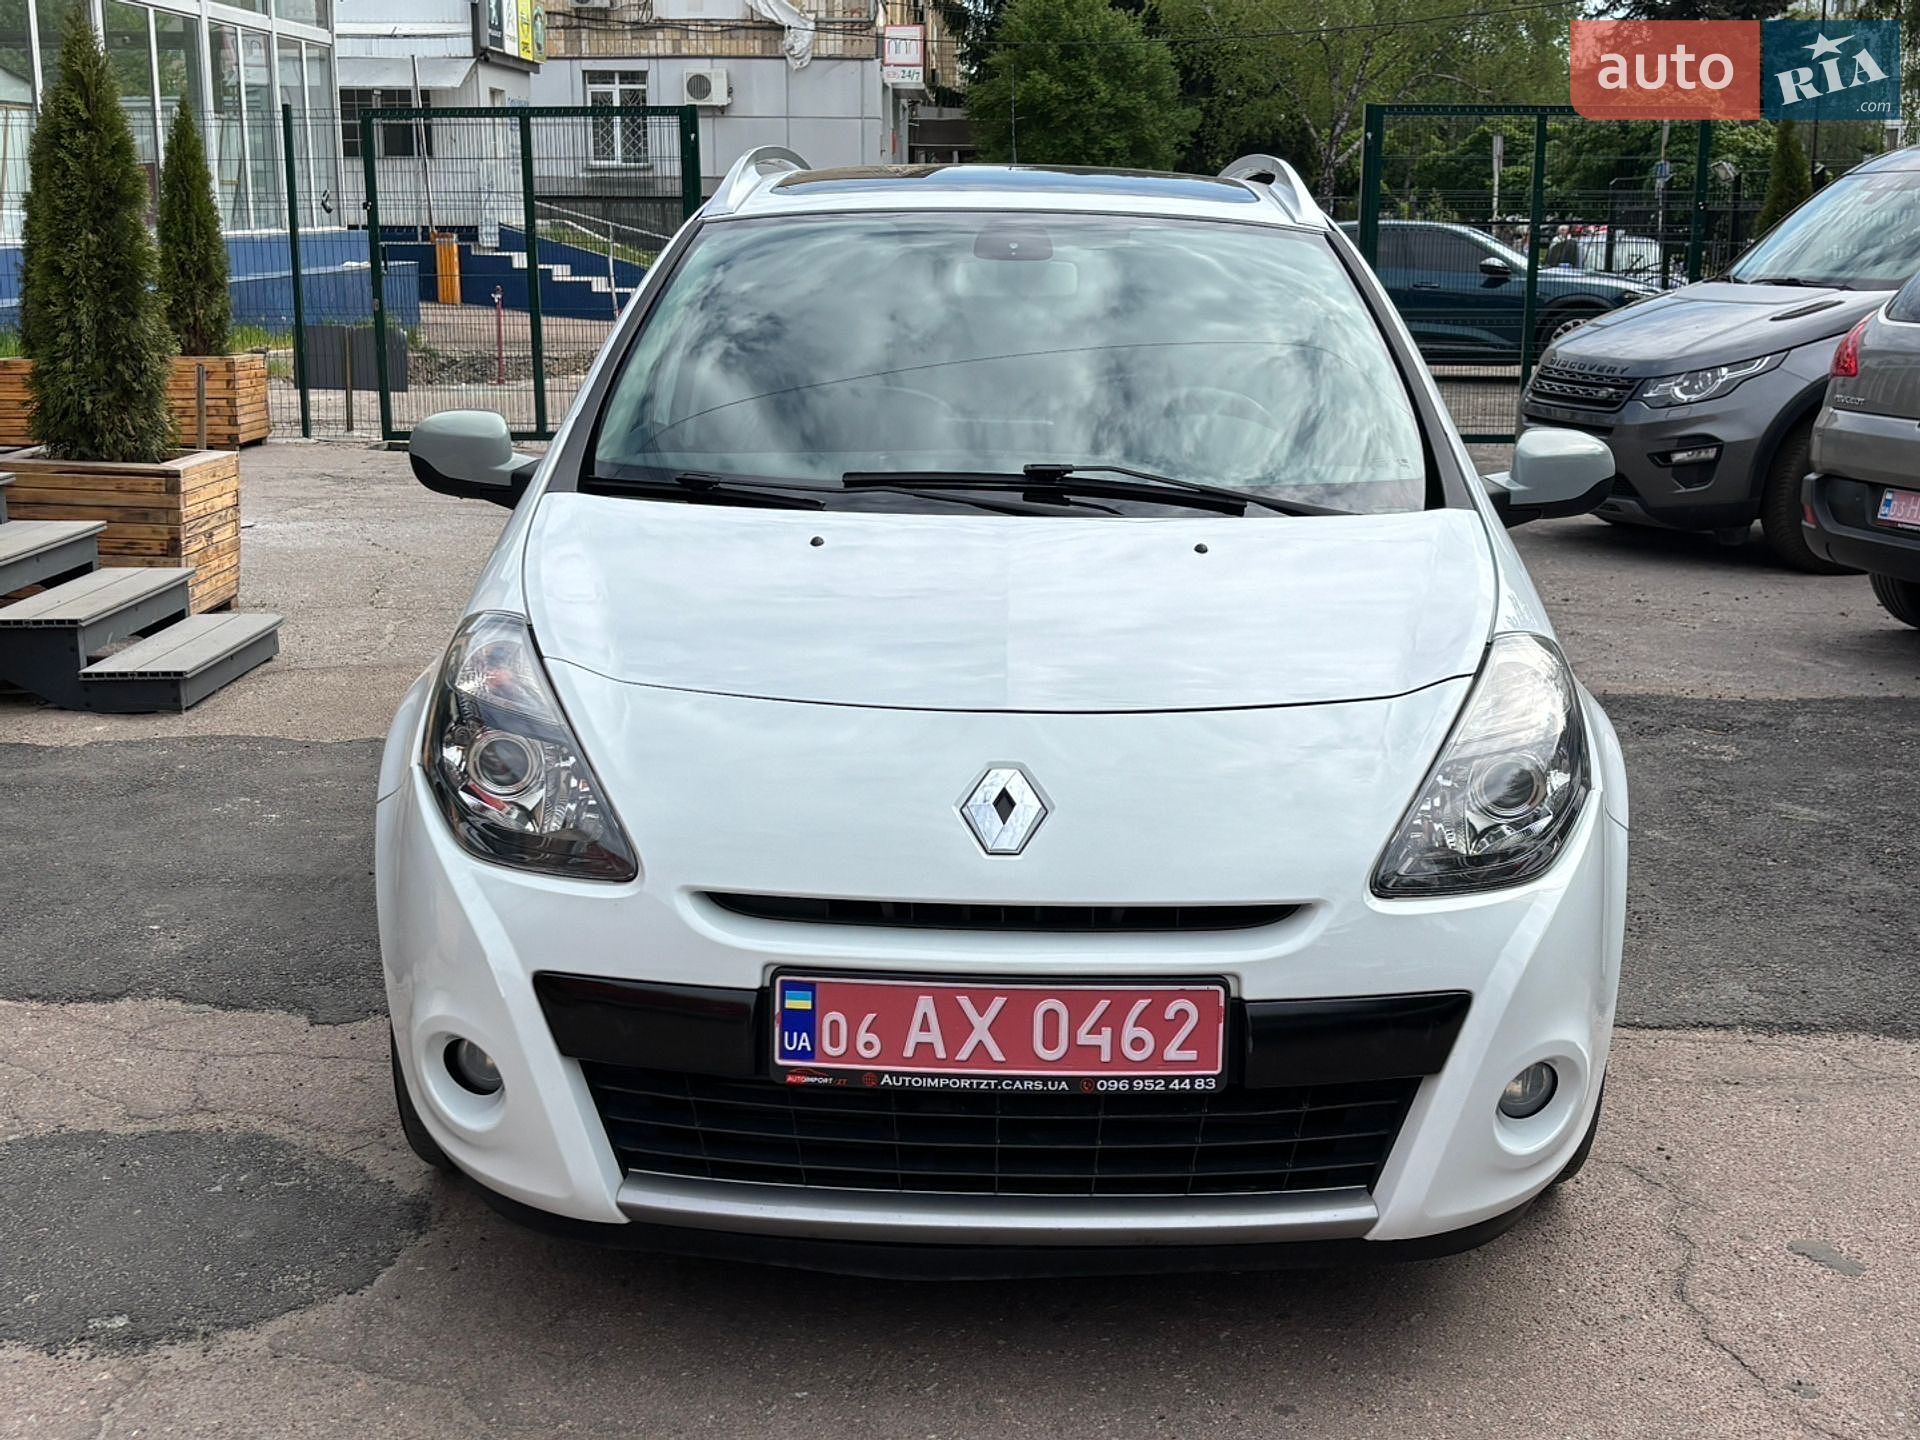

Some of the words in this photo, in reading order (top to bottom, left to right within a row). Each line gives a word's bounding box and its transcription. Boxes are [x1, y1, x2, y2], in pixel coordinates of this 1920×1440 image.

[1906, 496, 1920, 518] H
[822, 1011, 882, 1059] 06
[902, 995, 1008, 1062] AX
[1033, 998, 1199, 1062] 0462
[784, 1031, 812, 1052] UA
[1096, 1079, 1129, 1091] 096
[1132, 1079, 1166, 1091] 952
[1168, 1079, 1191, 1090] 44
[1194, 1078, 1217, 1090] 83
